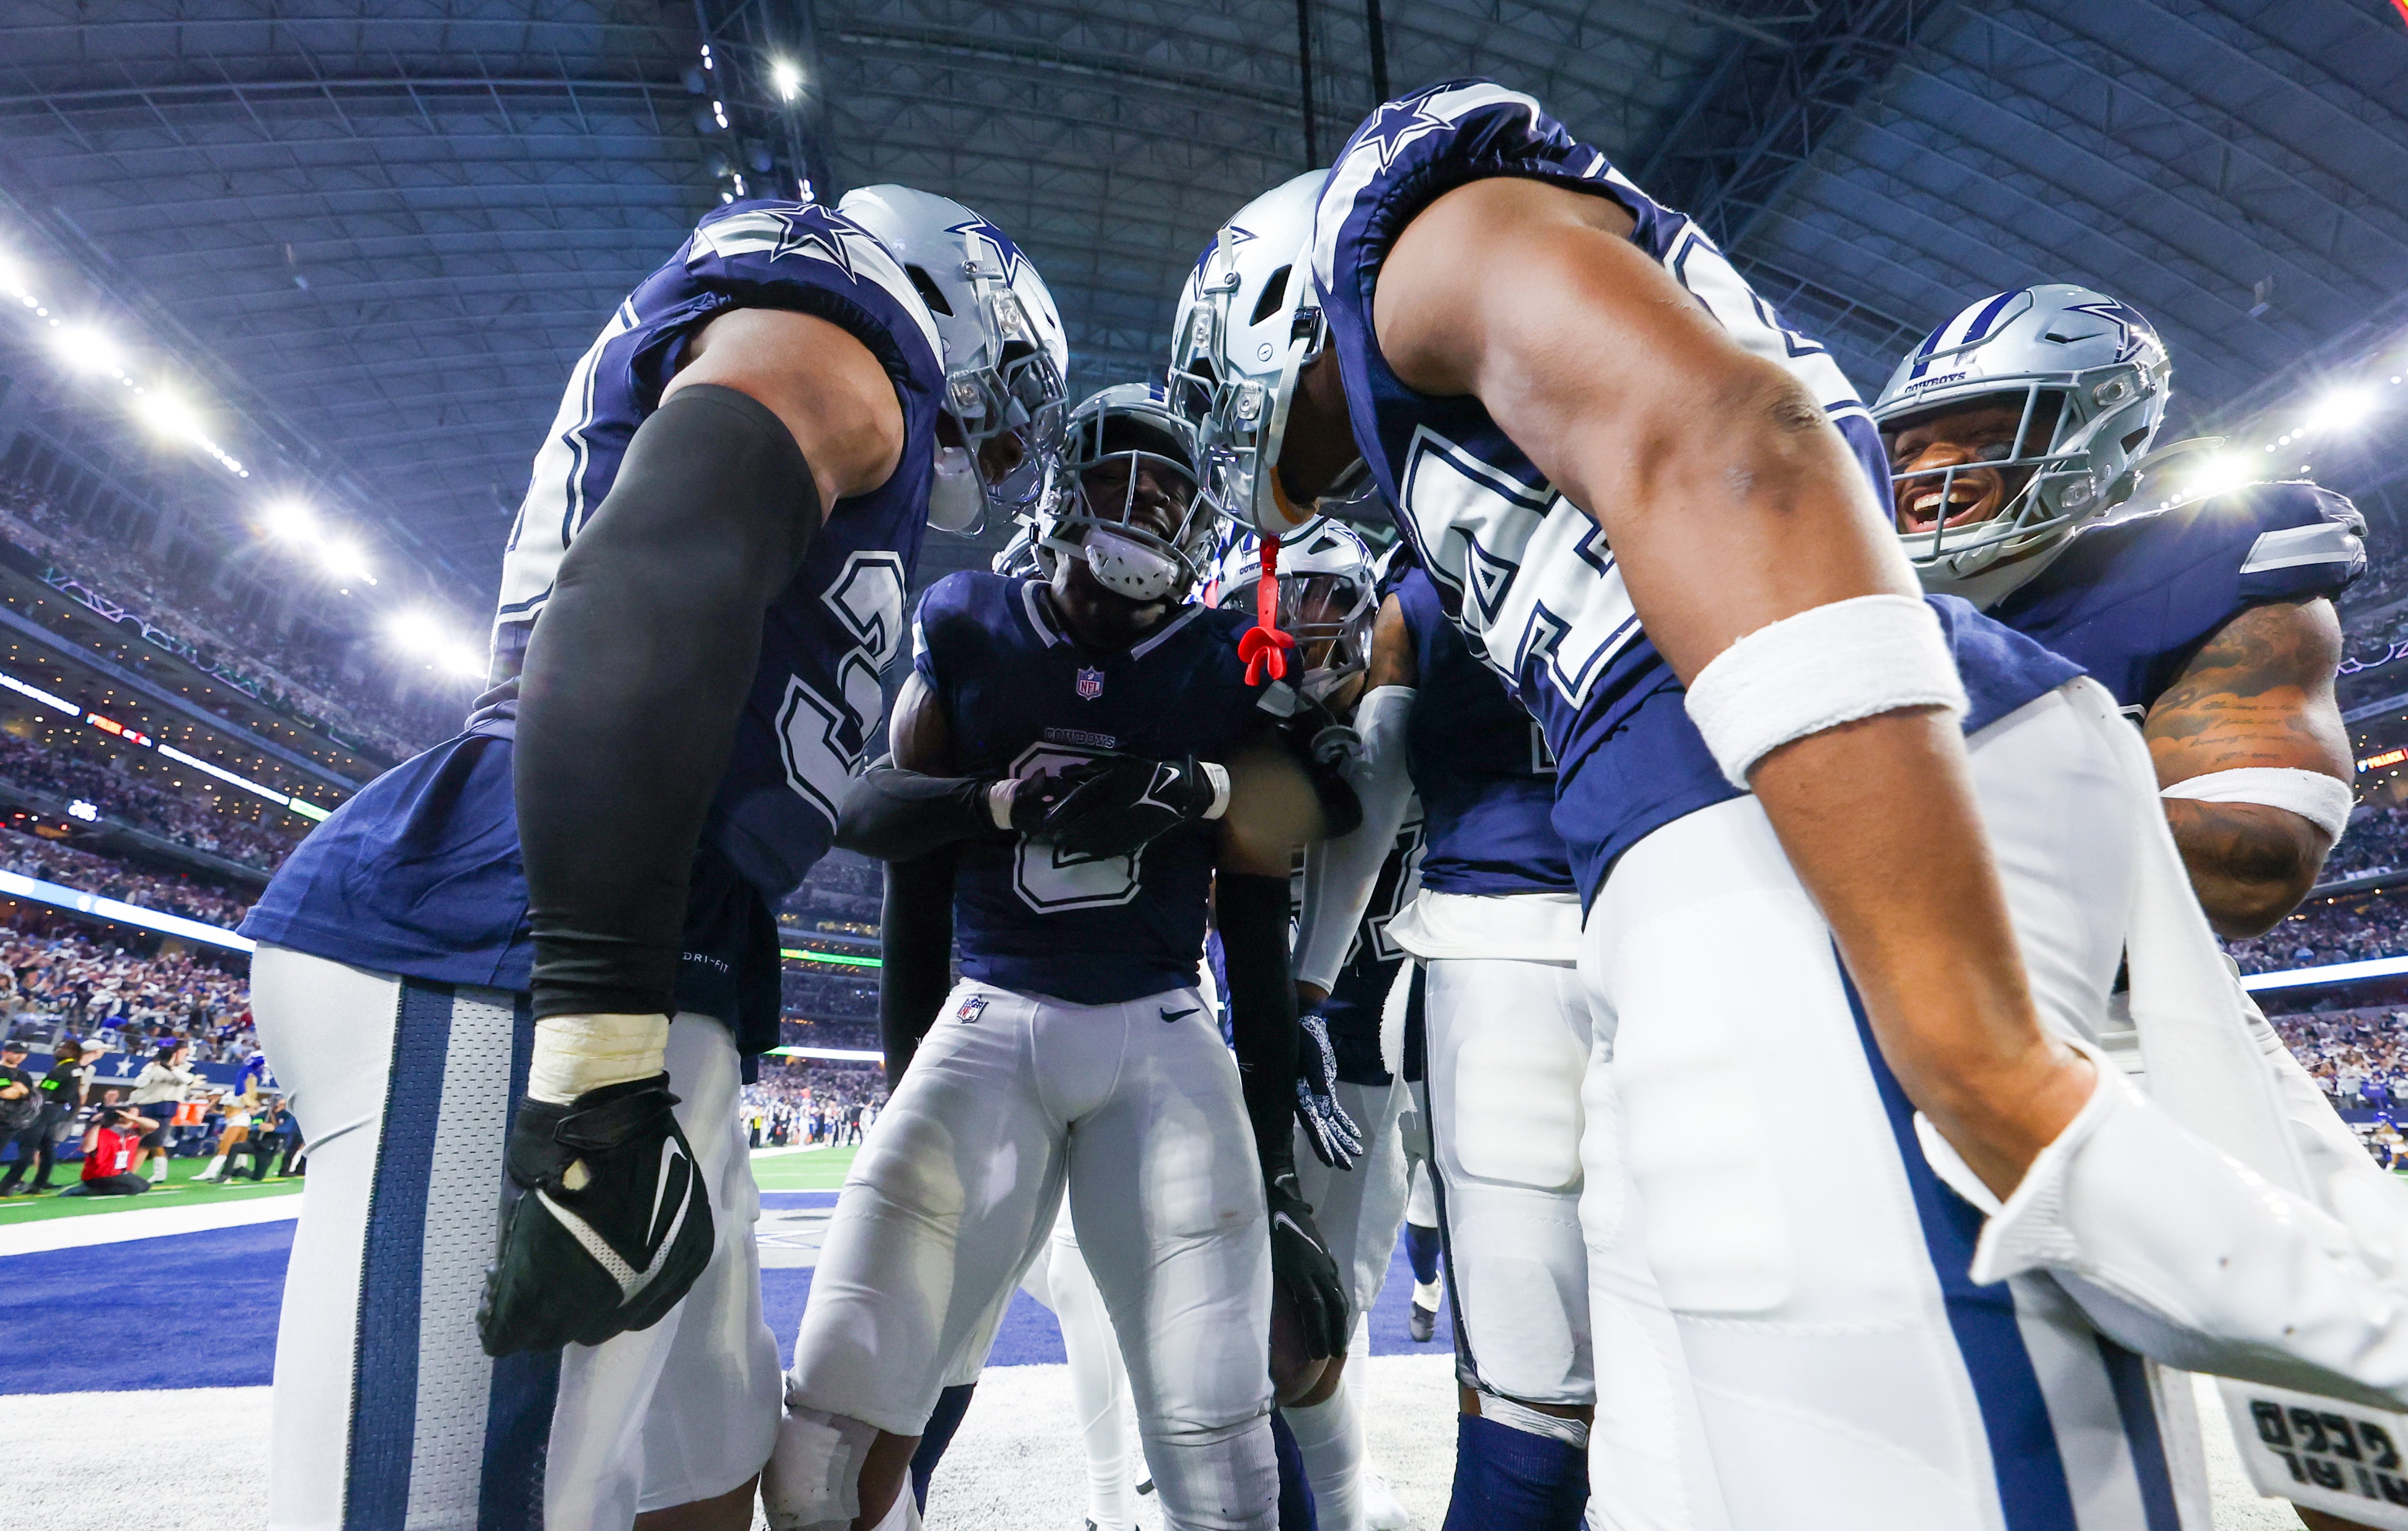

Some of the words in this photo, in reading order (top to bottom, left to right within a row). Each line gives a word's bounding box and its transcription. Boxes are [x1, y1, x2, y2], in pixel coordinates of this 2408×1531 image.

[1905, 371, 1966, 393] COWBOYS
[1239, 561, 1262, 575] COWB
[1081, 681, 1098, 694] NFL
[1045, 727, 1116, 749] COWBOYS
[682, 952, 728, 973] DRI-FIT
[958, 1007, 976, 1019] NFL
